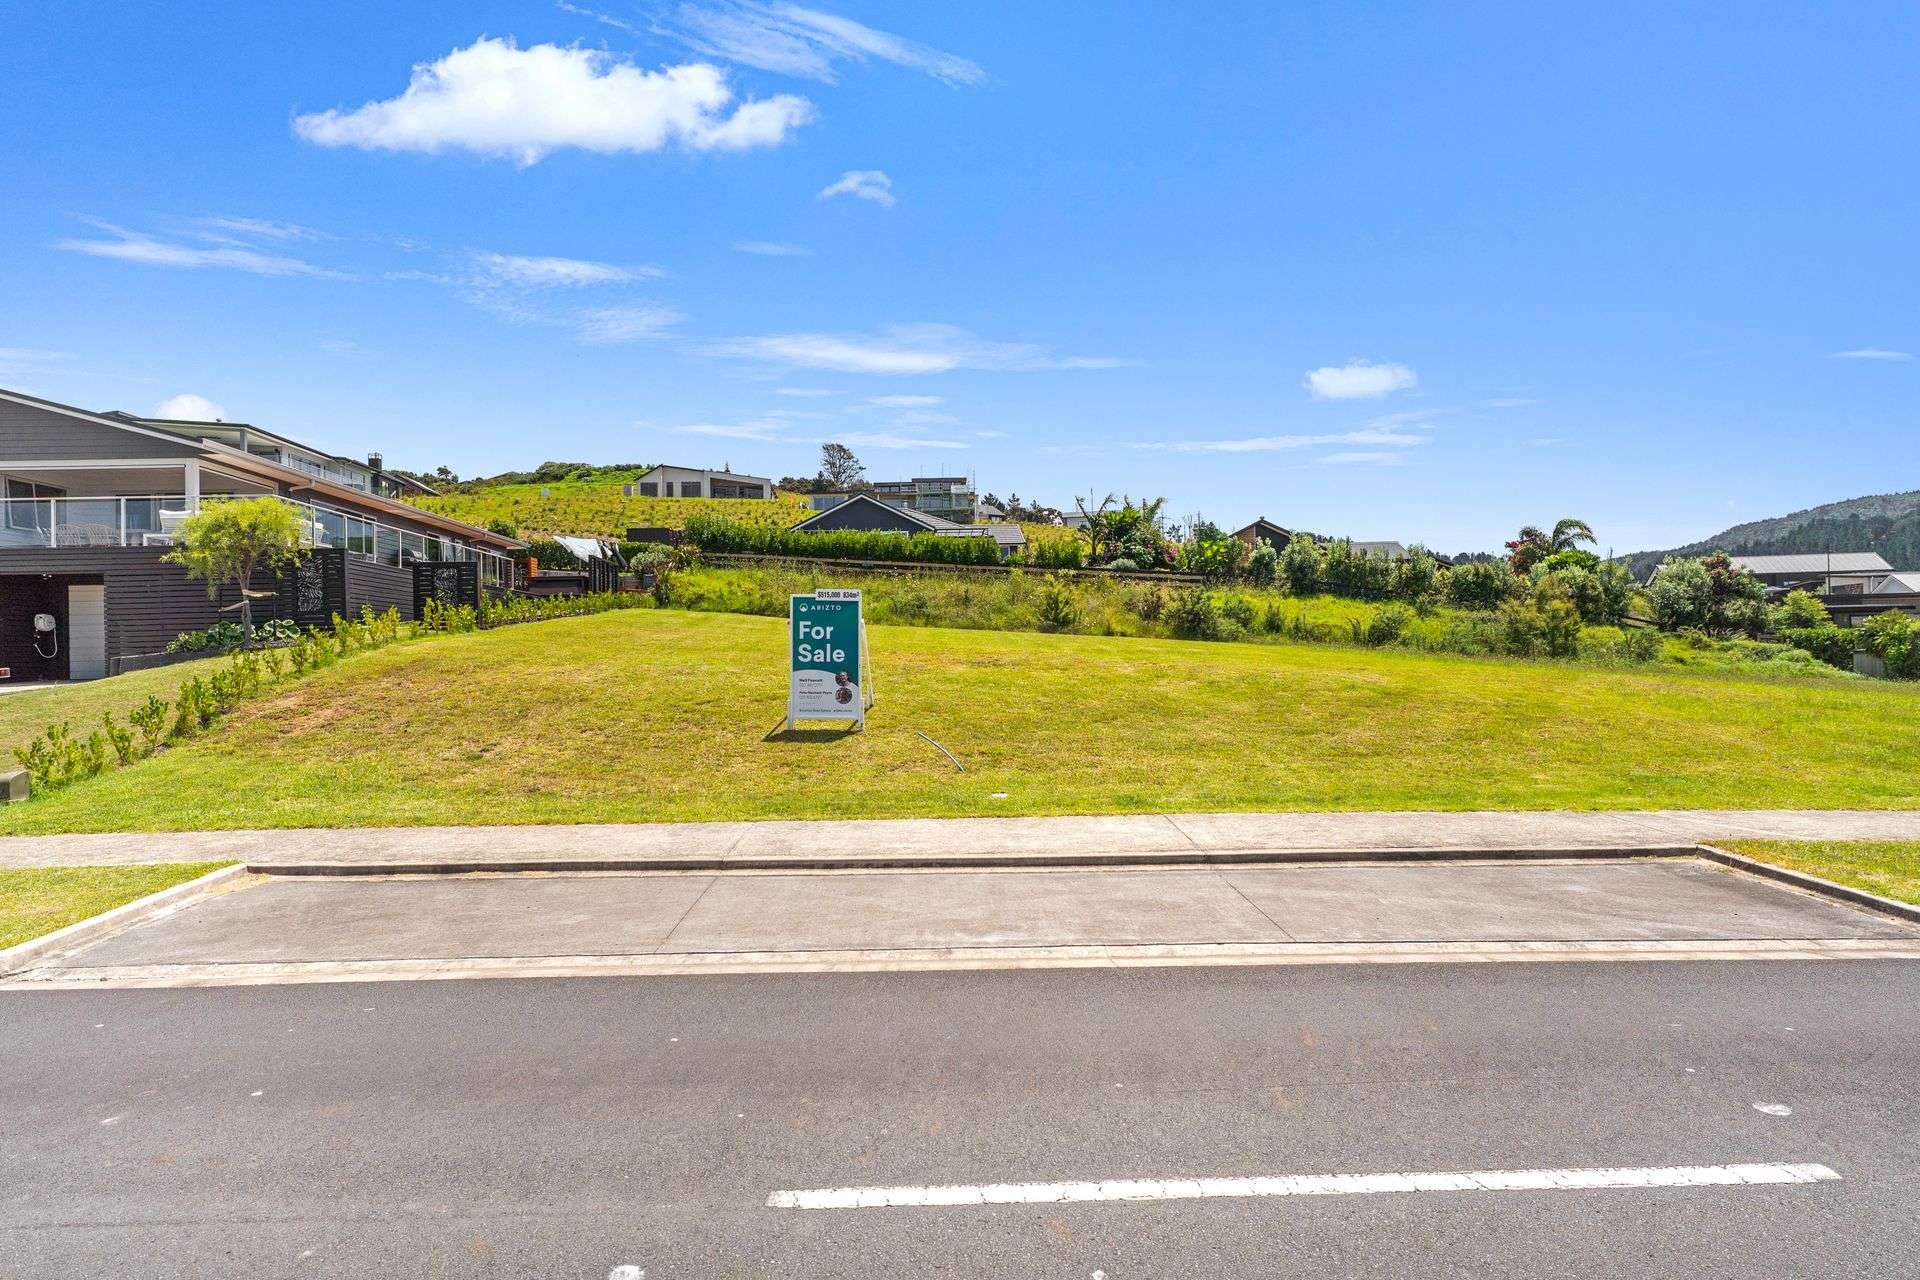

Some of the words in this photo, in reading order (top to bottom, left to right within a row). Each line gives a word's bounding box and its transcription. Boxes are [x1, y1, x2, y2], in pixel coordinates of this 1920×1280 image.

[811, 603, 842, 611] ARIZTO
[799, 620, 834, 640] For
[798, 643, 845, 663] Sale
